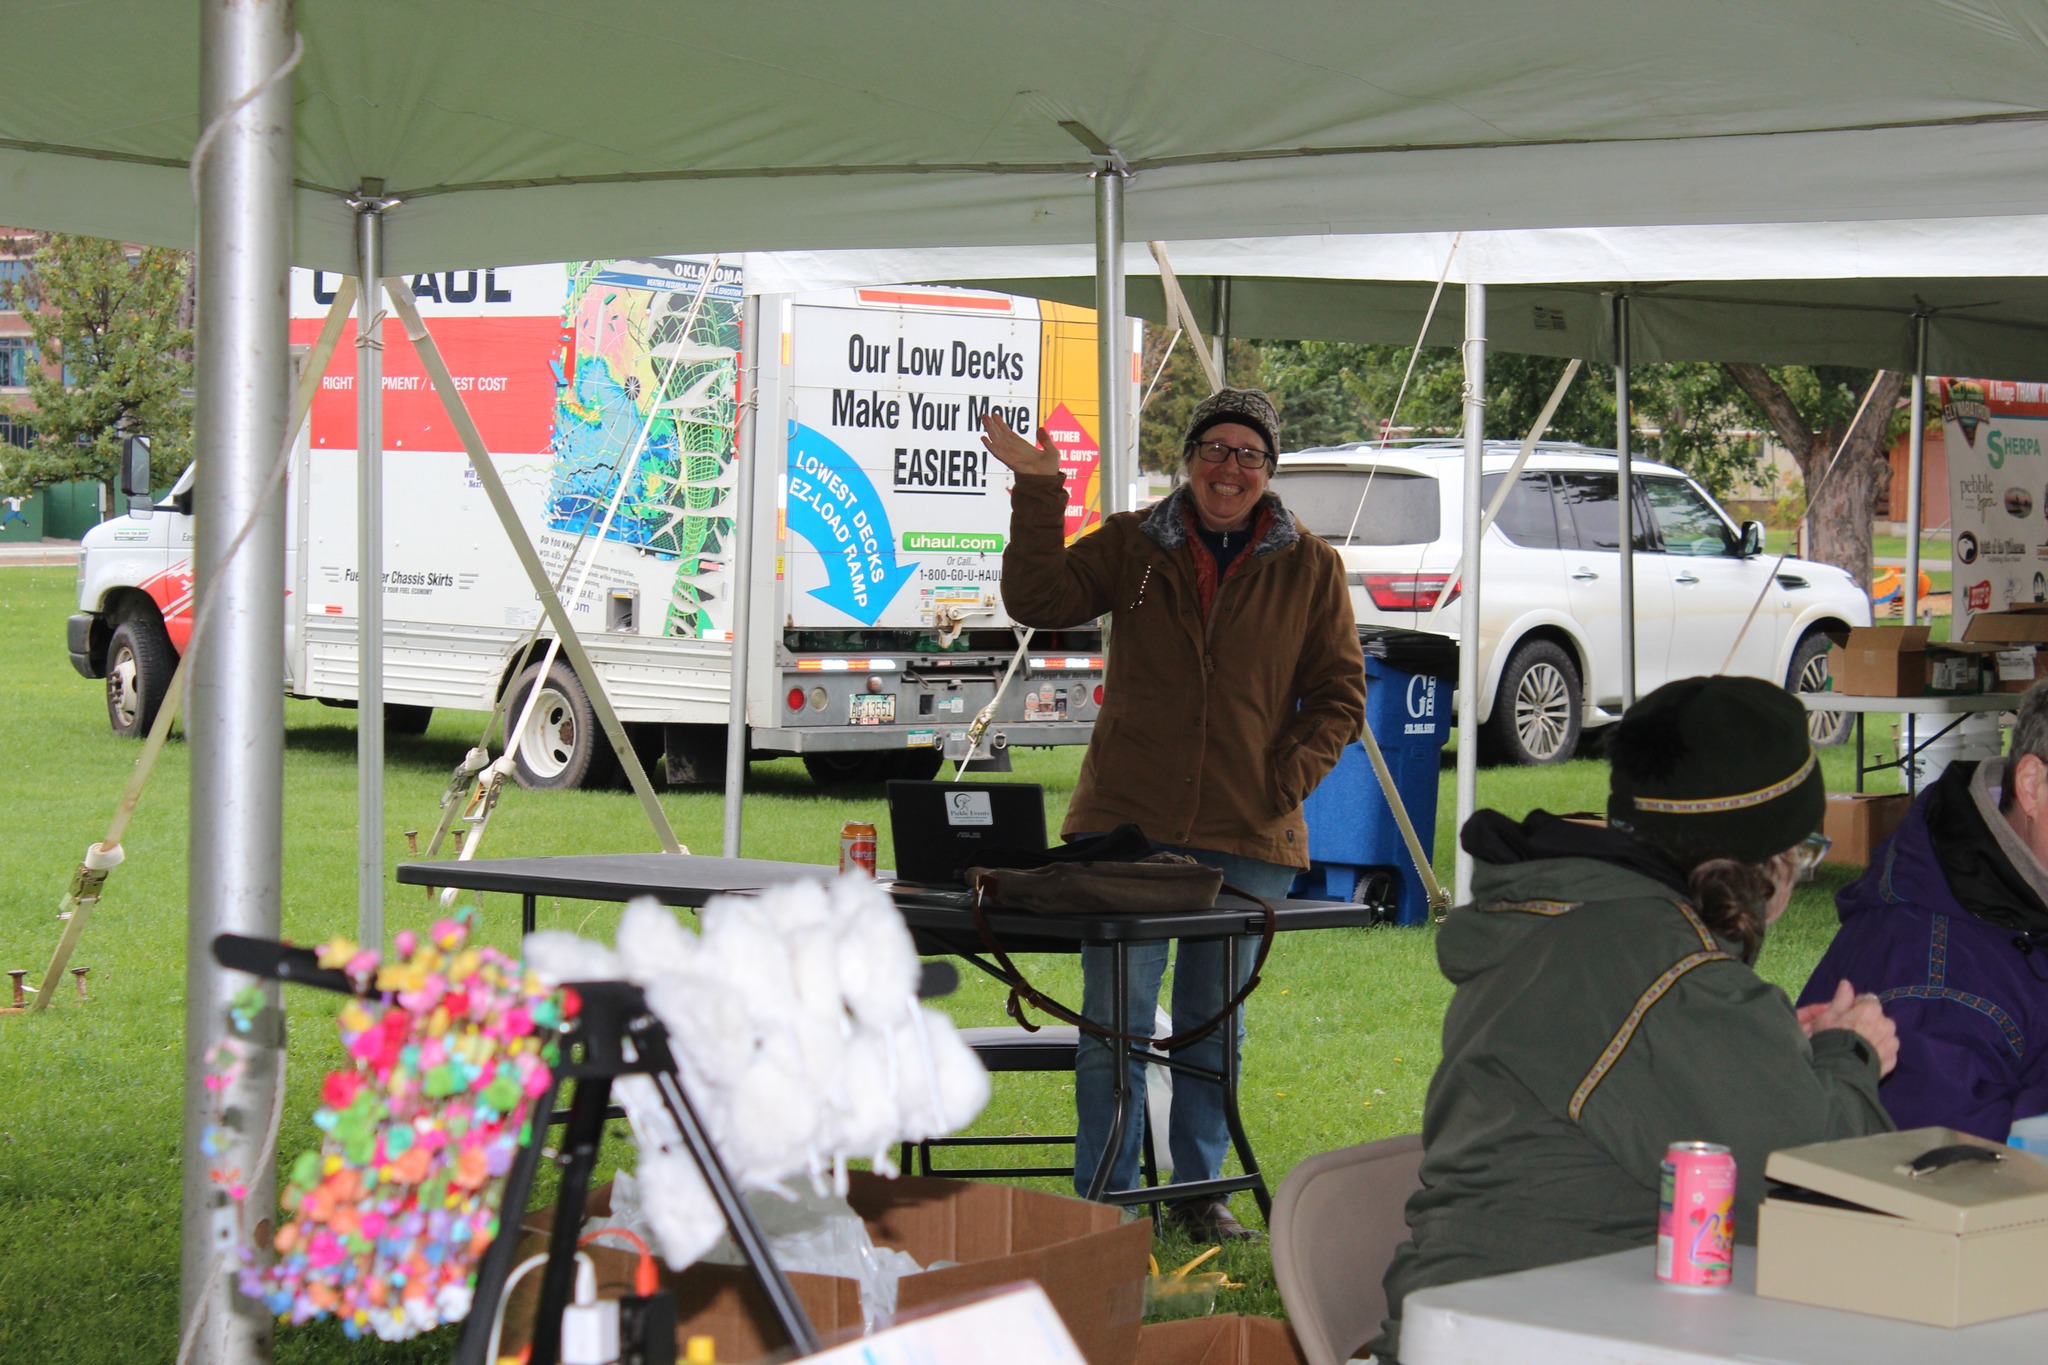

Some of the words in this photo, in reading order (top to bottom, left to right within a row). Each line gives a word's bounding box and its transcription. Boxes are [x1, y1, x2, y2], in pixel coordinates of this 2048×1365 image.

[674, 263, 742, 283] OKLAOMA
[849, 334, 890, 373] Our
[897, 337, 944, 376] Low
[951, 341, 1023, 381] Decks
[323, 376, 354, 390] RIGHT
[431, 377, 475, 391] LEST
[478, 377, 507, 391] COST
[832, 389, 899, 429] Make
[908, 392, 960, 430] Your
[1987, 430, 2041, 470] SHERPA
[894, 448, 987, 487] EASIER!
[1960, 474, 1994, 500] pebble
[796, 451, 857, 509] LOWEST
[853, 510, 884, 583] DECKS
[789, 477, 849, 543] EZ-LOAD
[843, 543, 868, 607] RAMP
[911, 535, 996, 549] uhaul.com
[947, 556, 955, 565] Or
[345, 568, 359, 582] Fue
[391, 571, 425, 585] Chassis
[427, 573, 453, 587] Skirts
